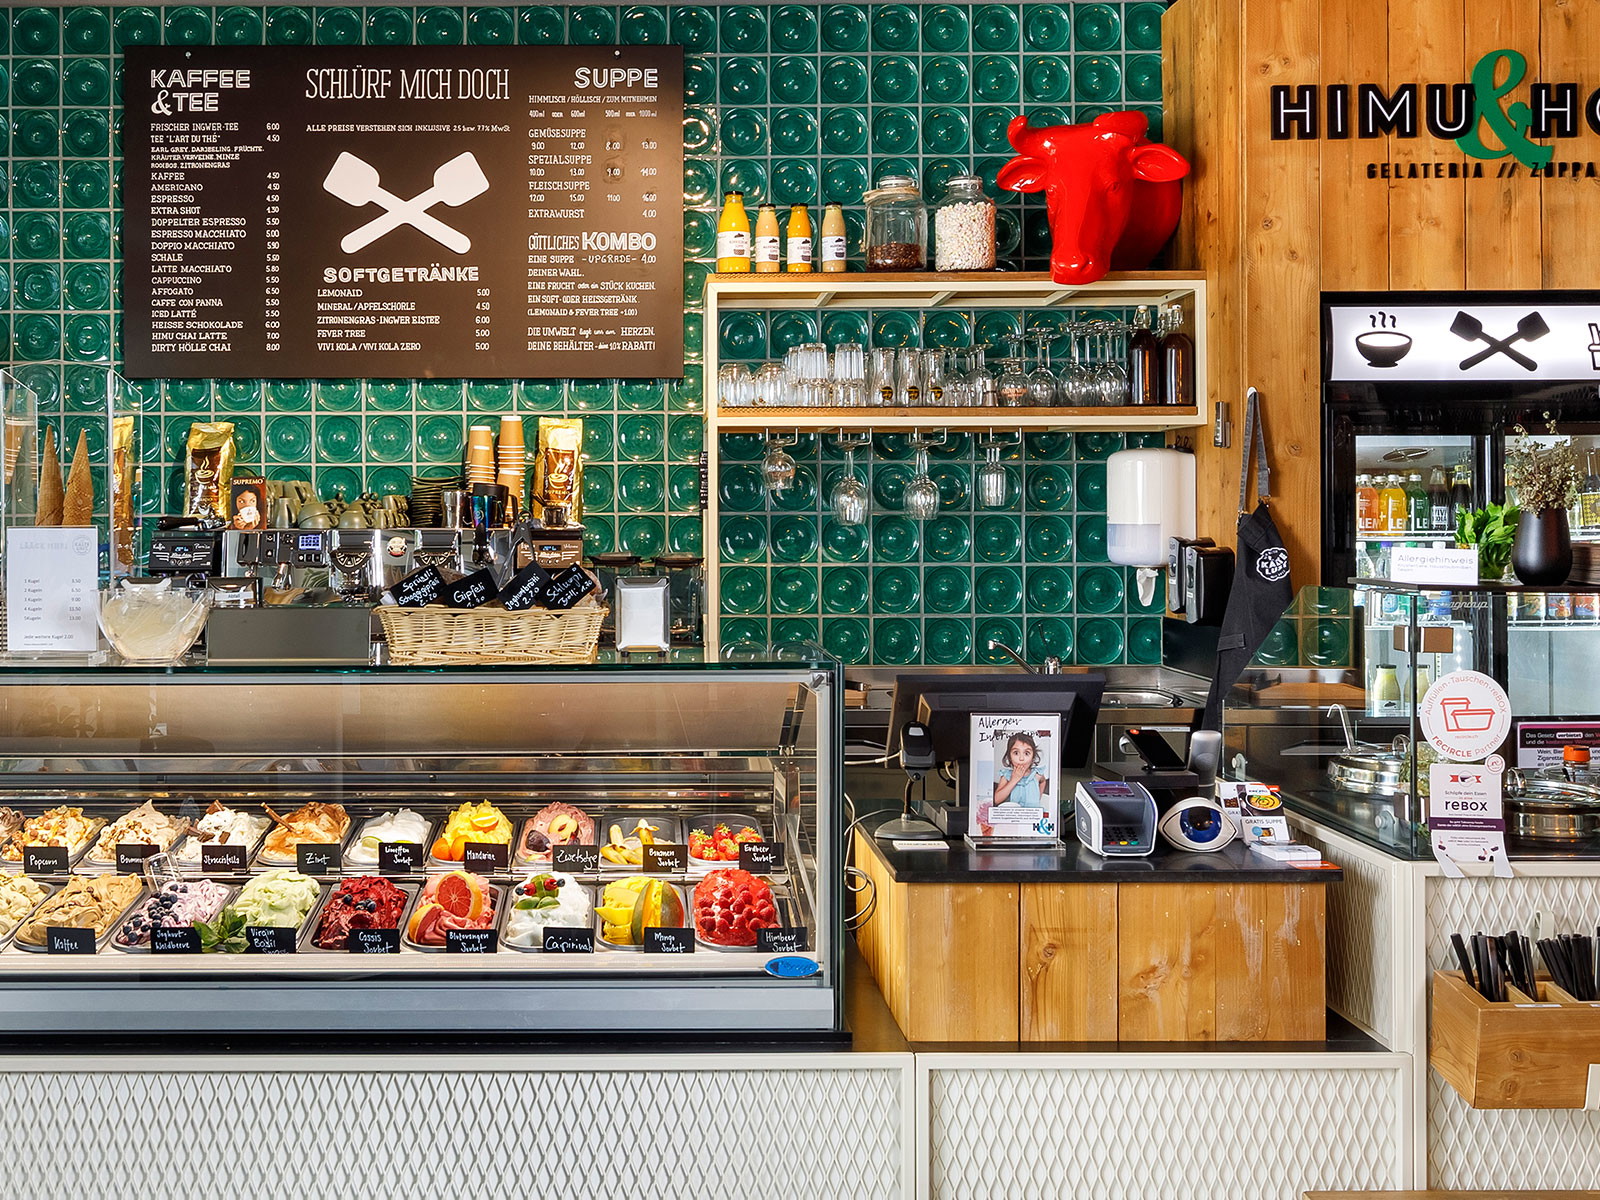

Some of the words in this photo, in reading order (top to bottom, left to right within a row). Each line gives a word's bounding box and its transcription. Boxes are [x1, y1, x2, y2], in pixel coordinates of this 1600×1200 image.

[150, 69, 251, 89] KAFFEE
[305, 64, 392, 99] SCHLÜRF
[399, 68, 452, 100] MICH
[457, 68, 510, 100] DOCH
[574, 66, 658, 89] SUPPE
[150, 123, 190, 131] FRISCHER
[306, 124, 326, 132] ALLE
[327, 124, 355, 132] PREISE
[356, 124, 396, 132] VERSTEHEN
[528, 127, 586, 138] GEMÜSESUPPE
[150, 135, 164, 143] TEE
[191, 135, 201, 143] DU
[528, 155, 592, 165] SPEZIALSUPPE
[150, 172, 185, 180] KAFFEE
[1366, 162, 1484, 180] GELATERIA
[528, 181, 590, 190] FLEISCHSUPPE
[150, 195, 195, 203] ESPRESSO
[150, 207, 179, 215] EXTRA
[180, 207, 201, 215] SHOT
[528, 209, 585, 219] EXTRAWURST
[151, 218, 200, 227] DOPPELTER
[202, 218, 246, 227] ESPRESSO
[151, 229, 194, 238] ESPRESSO
[194, 229, 247, 238] MACCHIATO
[151, 242, 182, 250] DOPPIO
[184, 242, 235, 250] MACCHIATO
[528, 233, 580, 251] GÖTTLICHES
[582, 232, 657, 251] KOMBO
[151, 254, 183, 262] SCHALE
[528, 255, 547, 263] EINE
[550, 255, 574, 263] SUPPE
[151, 265, 178, 273] LATTE
[180, 265, 232, 273] MACCHIATO
[323, 262, 479, 284] SOFTGETRÄNKE
[528, 269, 558, 277] DEINER
[528, 282, 546, 290] EINE
[547, 282, 575, 290] FRUCHT
[600, 280, 624, 290] STÜCK
[317, 289, 363, 297] LEMONAID
[528, 295, 541, 303] EIN
[563, 295, 580, 303] ODER
[151, 310, 169, 318] ICED
[575, 308, 599, 316] FEVER
[600, 308, 618, 316] TREE
[151, 321, 184, 329] HEISSE
[185, 321, 243, 329] SCHOKOLADE
[411, 316, 440, 324] EISTEE
[152, 332, 174, 340] HIMU
[175, 332, 197, 340] CHAI
[198, 332, 228, 340] LATTE
[317, 329, 343, 338] FEVER
[344, 329, 366, 338] TREE
[527, 327, 541, 336] DIE
[542, 327, 576, 336] UMWELT
[151, 343, 176, 352] DIRTY
[178, 342, 207, 352] HÖLLE
[209, 343, 231, 352] CHAI
[317, 342, 335, 351] VIVI
[336, 342, 357, 351] KOLA
[378, 342, 400, 351] KOLA
[400, 342, 421, 351] ZERO
[527, 341, 551, 351] DEINE
[553, 340, 594, 351] BEHÄLTER
[1398, 555, 1474, 564] Allergiehinweis
[453, 581, 485, 603] Gipfeli
[1425, 681, 1449, 715] Auffüllen
[1450, 676, 1489, 689] Tauschen
[1432, 736, 1472, 757] reCIRCLE
[1475, 734, 1501, 755] Partner
[649, 848, 675, 857] Bananen
[744, 844, 770, 853] Erdbeer
[466, 850, 496, 861] Mandarine
[751, 852, 777, 863] Sorbet
[29, 855, 58, 870] Popcorn
[657, 857, 681, 869] Sorbet
[250, 928, 275, 942] Virgin
[358, 931, 382, 942] Cassis
[654, 932, 676, 945] Mango
[766, 932, 797, 942] Himbeer
[54, 937, 79, 952] Kaffee
[363, 942, 394, 954] Sorbet
[461, 942, 487, 953] Sorbet
[661, 943, 686, 953] Sorbet
[772, 943, 802, 953] Sorbet
